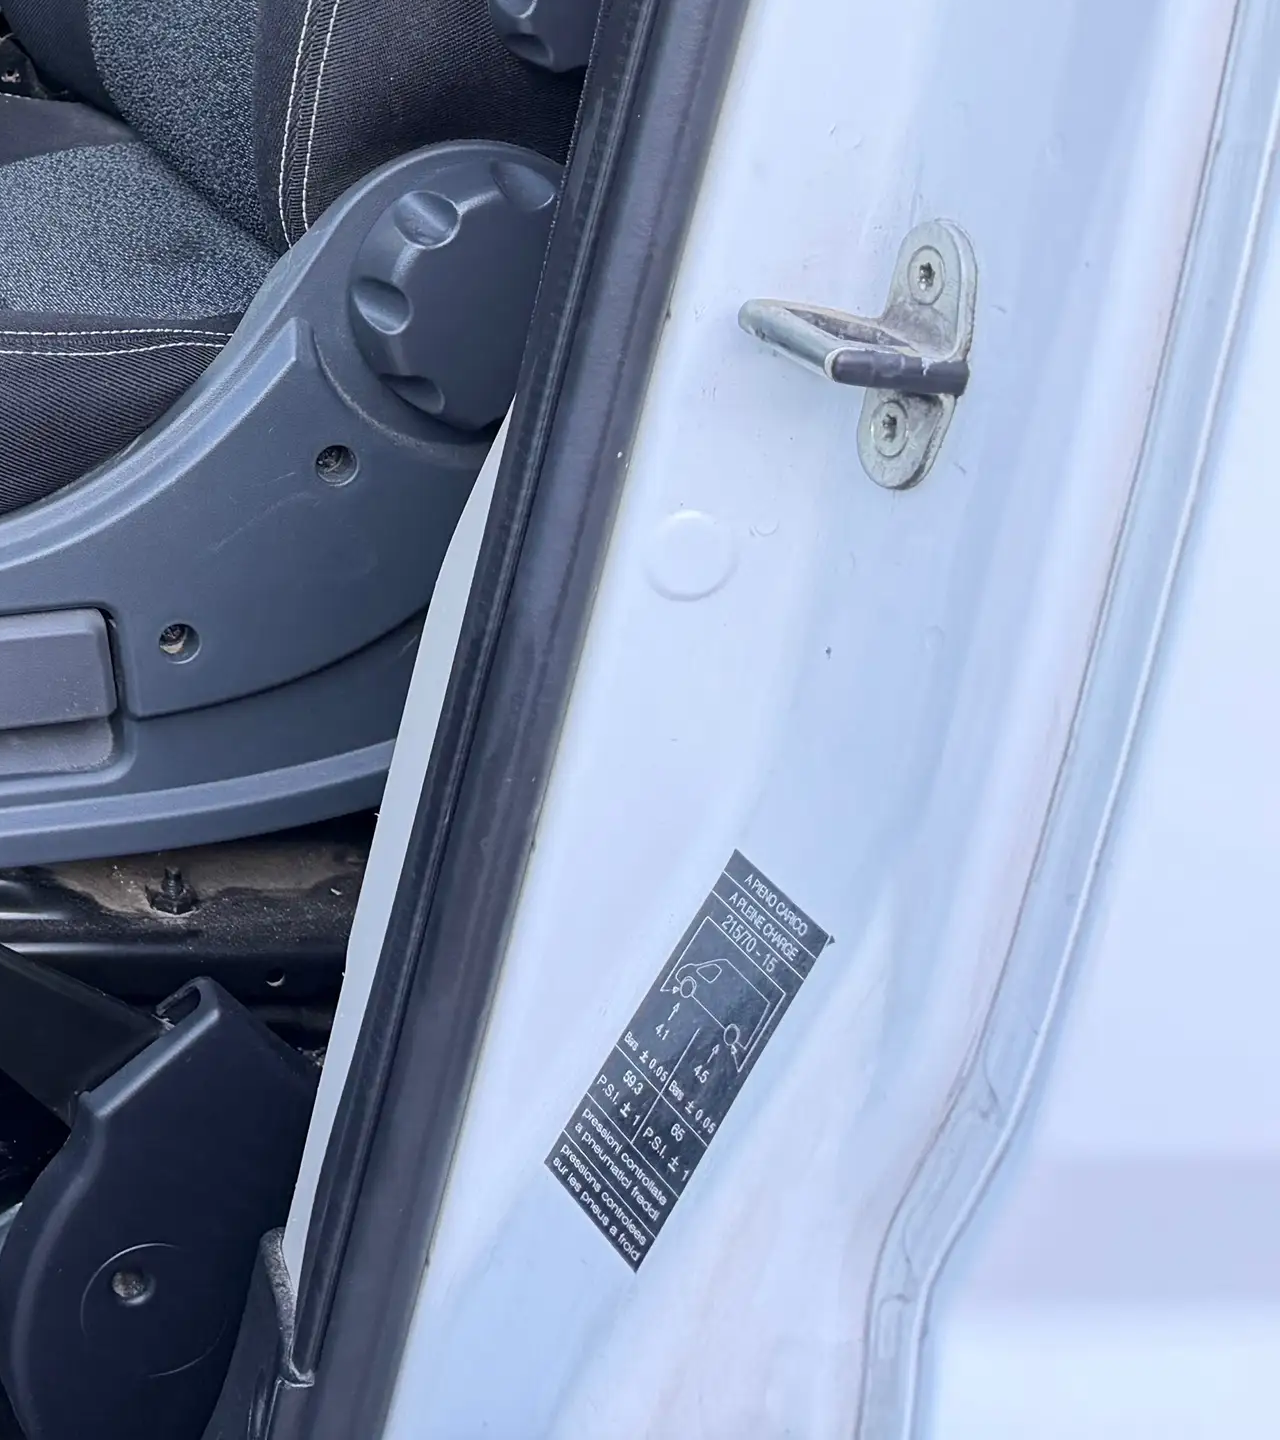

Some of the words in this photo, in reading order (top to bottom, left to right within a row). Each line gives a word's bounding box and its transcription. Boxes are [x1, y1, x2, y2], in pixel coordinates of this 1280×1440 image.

[729, 892, 739, 904] A
[736, 897, 766, 930] PLEINE
[762, 923, 799, 961] CHARGE
[744, 874, 753, 886] A
[751, 878, 778, 907] PIENO
[775, 901, 808, 937] CARICO
[721, 914, 757, 953] 215/70
[761, 953, 778, 973] 15
[624, 1031, 639, 1051] Bars
[648, 1058, 669, 1082] 0.05
[655, 1023, 670, 1040] 4.1
[597, 1074, 620, 1105] P.S.I.
[623, 1070, 644, 1095] 59.3
[693, 1065, 710, 1083] 4.5
[668, 1080, 684, 1101] Bars
[694, 1109, 717, 1134] 0.05
[670, 1123, 686, 1141] 65
[582, 1108, 623, 1154] pressioni
[621, 1152, 668, 1206] controllate
[643, 1127, 667, 1158] P.S.I.
[560, 1144, 602, 1193] pressions
[601, 1191, 648, 1246] controlees
[581, 1131, 633, 1189] pneumatici
[630, 1185, 661, 1222] freddi
[552, 1157, 569, 1176] sur
[567, 1172, 582, 1193] les
[580, 1191, 610, 1226] pneus
[617, 1233, 641, 1262] froid
